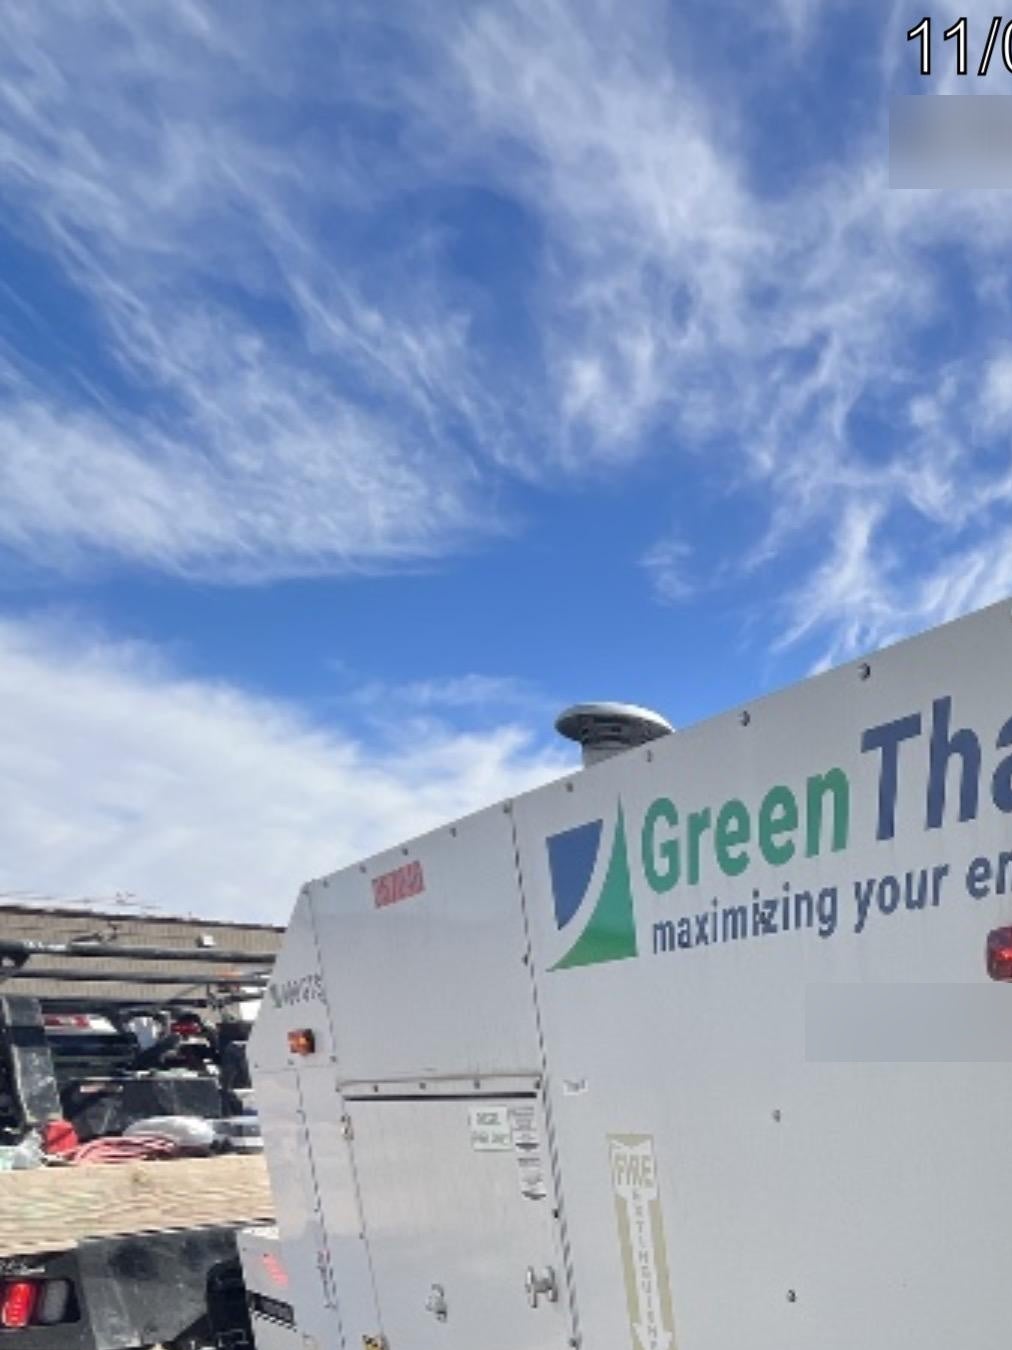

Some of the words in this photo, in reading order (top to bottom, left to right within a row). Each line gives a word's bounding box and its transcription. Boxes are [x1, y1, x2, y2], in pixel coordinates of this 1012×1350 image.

[652, 881, 838, 954] maximizing
[854, 862, 949, 934] your
[613, 1153, 655, 1190] FIRE
